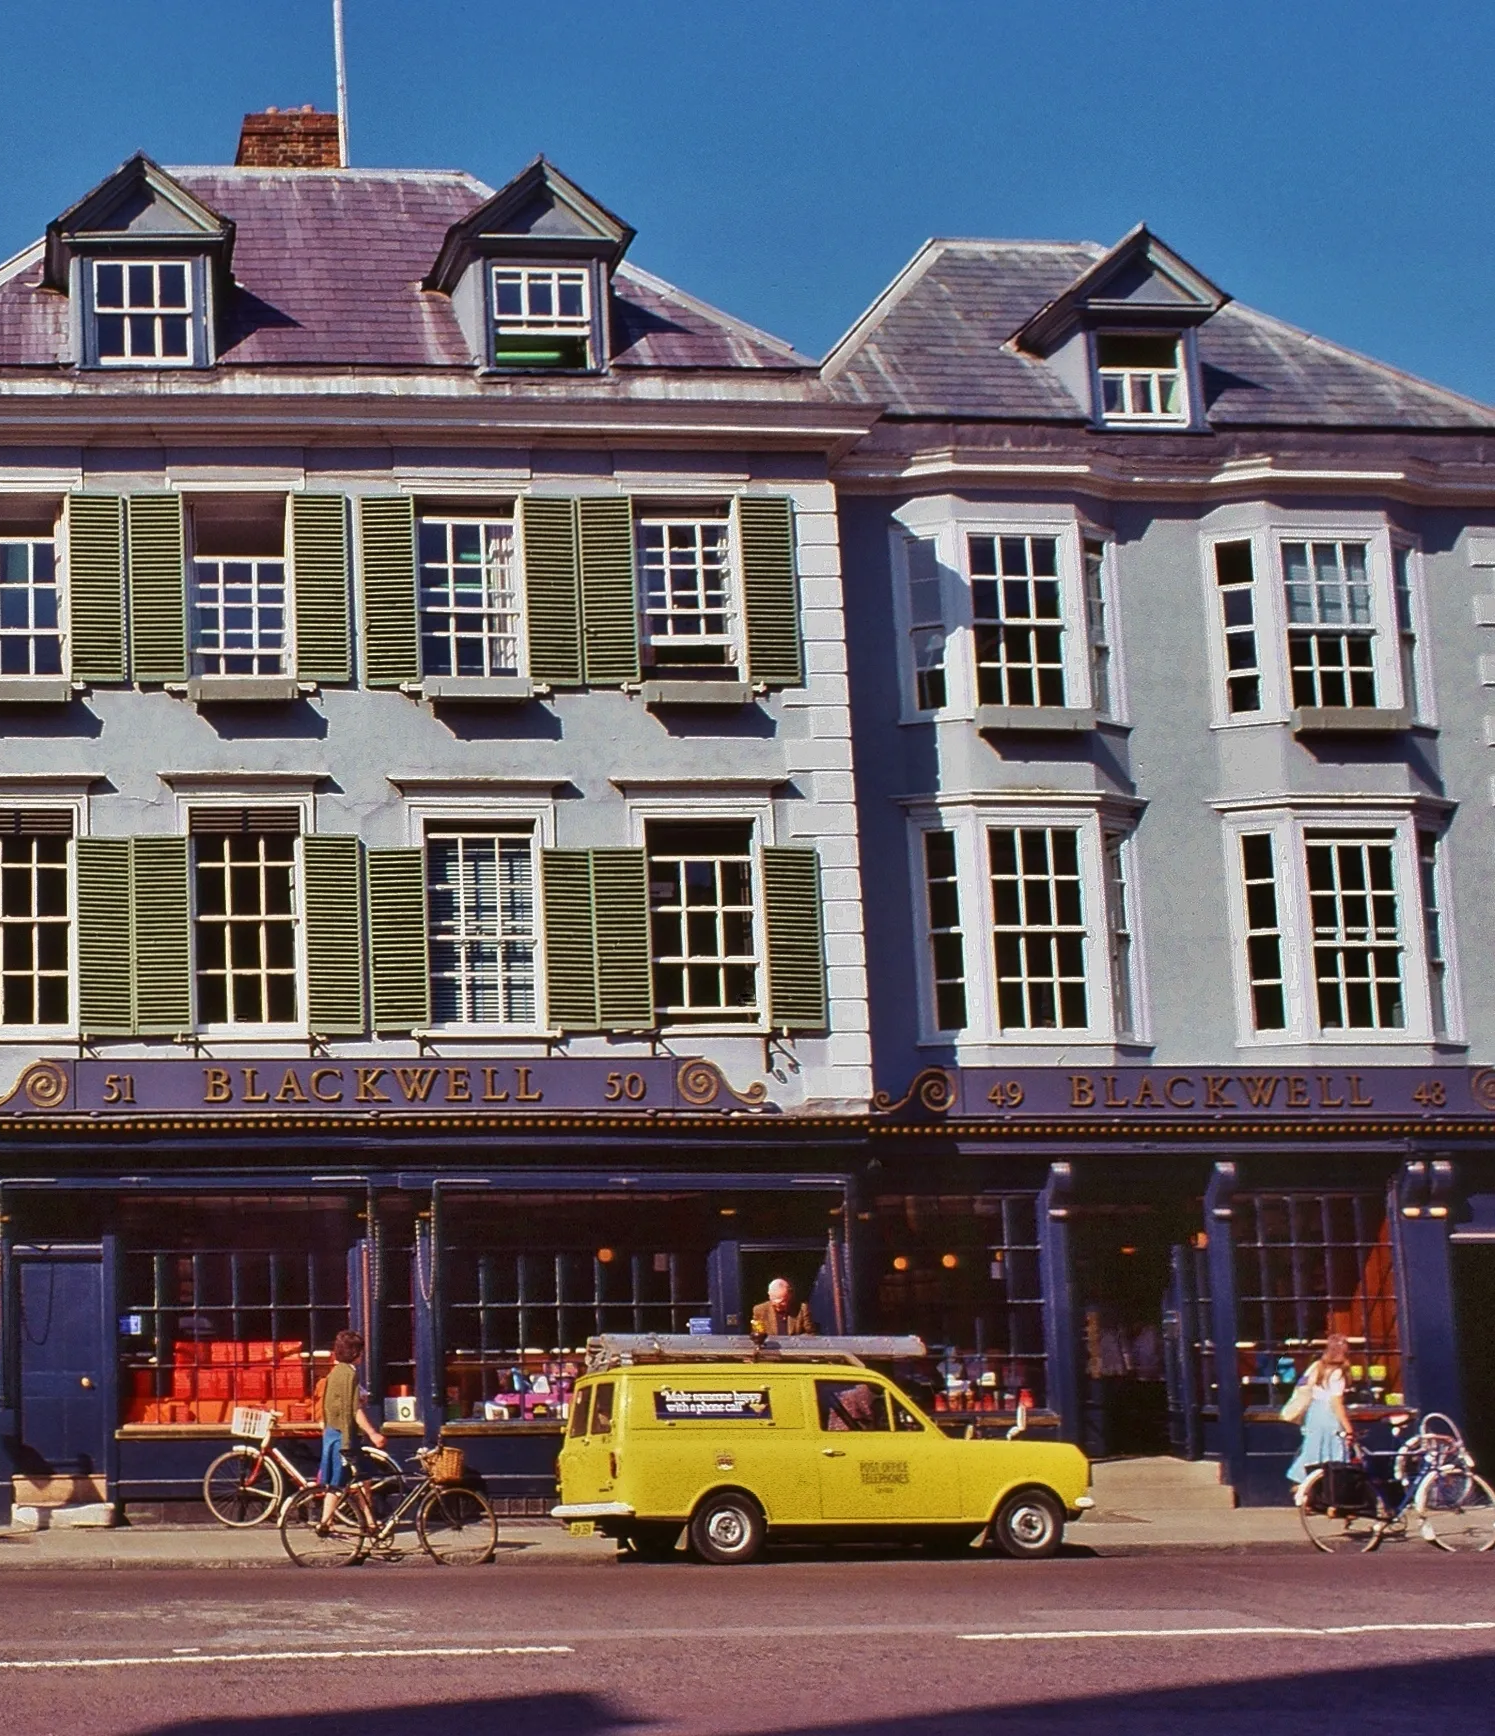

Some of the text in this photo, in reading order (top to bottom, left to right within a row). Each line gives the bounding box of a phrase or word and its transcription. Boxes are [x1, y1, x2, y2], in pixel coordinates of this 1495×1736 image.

[103, 1067, 647, 1103] 51 BLACKWELL 50
[987, 1074, 1446, 1108] 49 BLACKWELL 48
